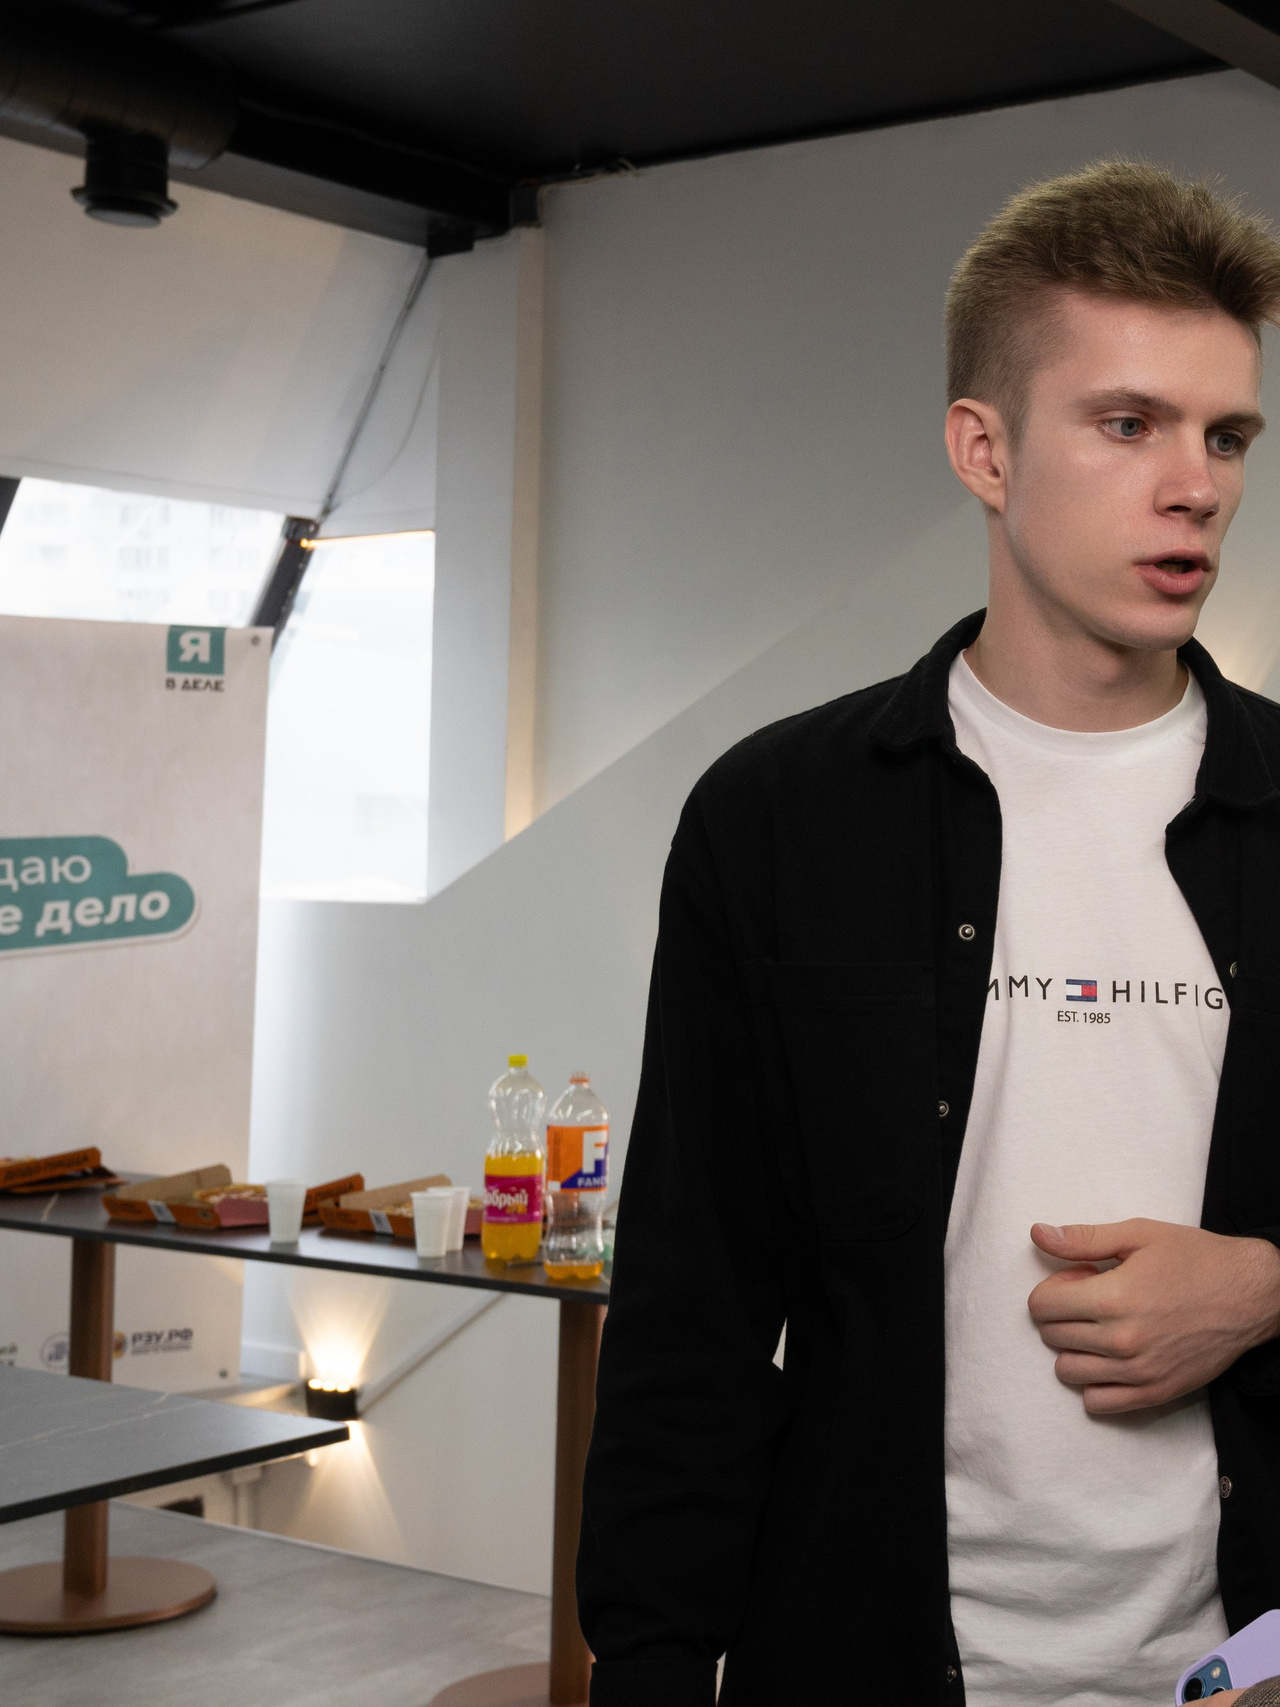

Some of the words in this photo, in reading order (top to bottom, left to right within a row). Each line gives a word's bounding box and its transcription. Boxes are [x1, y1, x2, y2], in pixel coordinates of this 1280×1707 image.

[179, 631, 211, 664] Я
[166, 678, 175, 691] В
[181, 678, 225, 692] ДЕЛЕ
[35, 890, 171, 938] дело
[1112, 980, 1225, 1010] HILFIG
[1057, 1010, 1080, 1023] EST.
[1083, 1012, 1112, 1025] 1985
